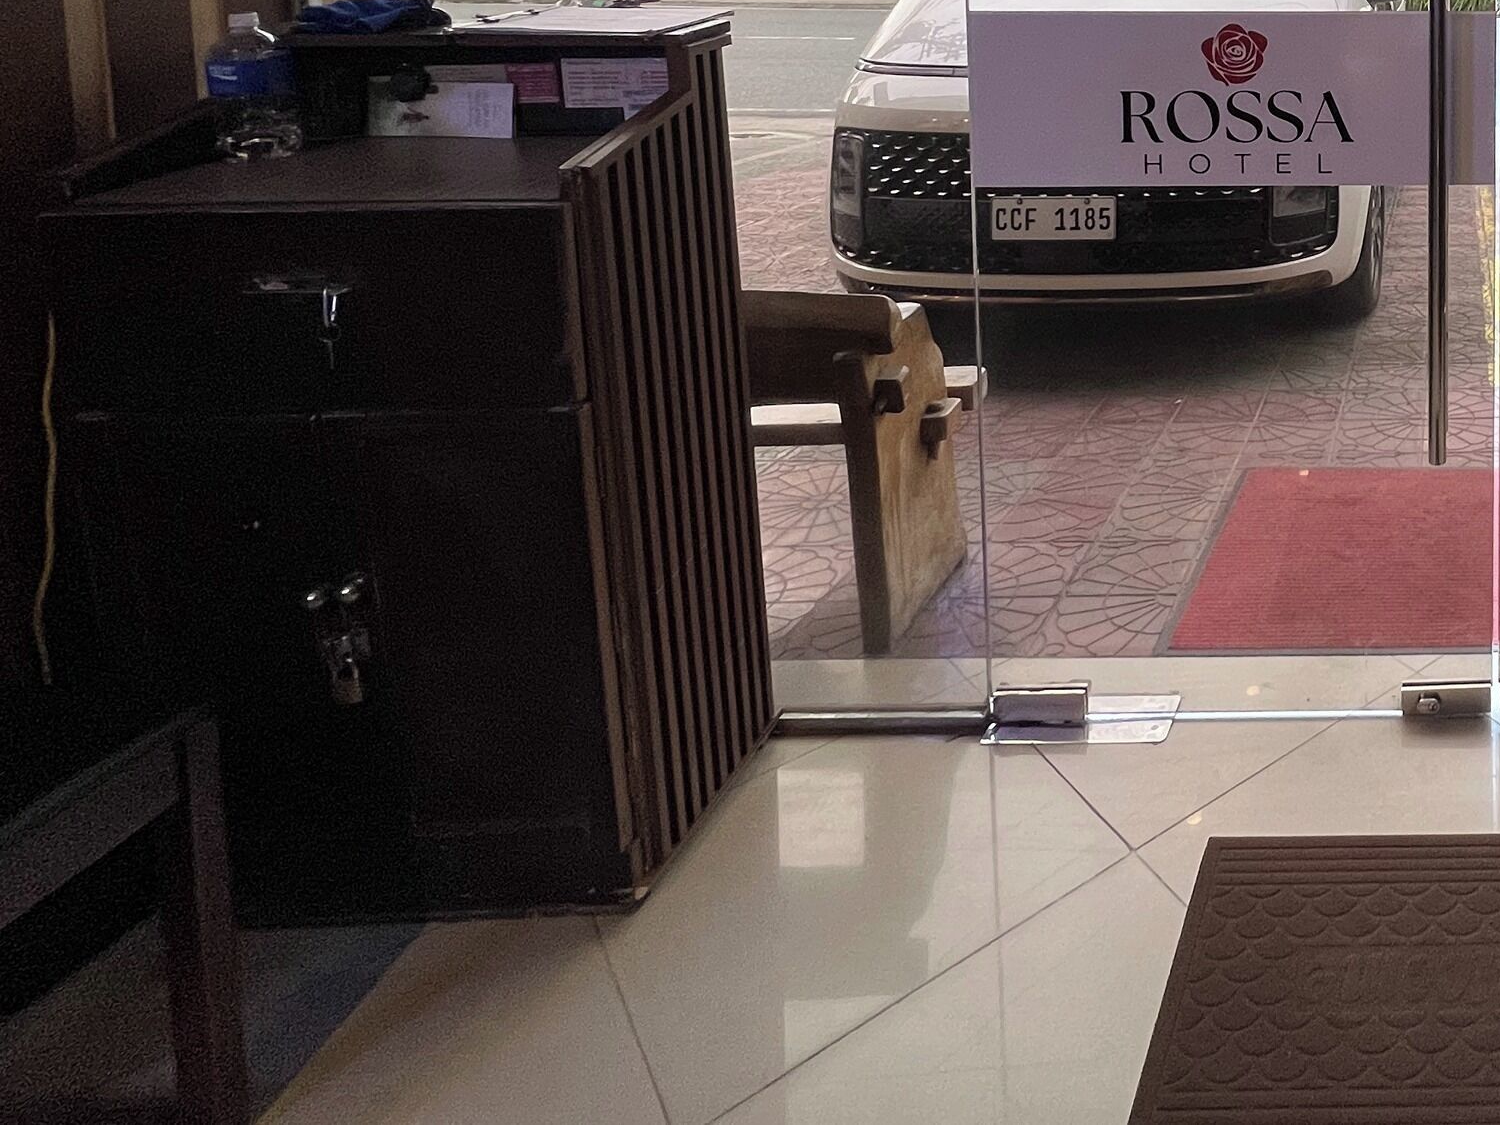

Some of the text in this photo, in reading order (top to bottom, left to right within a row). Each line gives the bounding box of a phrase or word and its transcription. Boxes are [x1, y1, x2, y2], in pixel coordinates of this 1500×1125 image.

[1120, 89, 1354, 143] ROSSA
[1143, 153, 1333, 174] HOTEL
[995, 207, 1111, 230] CCF 1185
